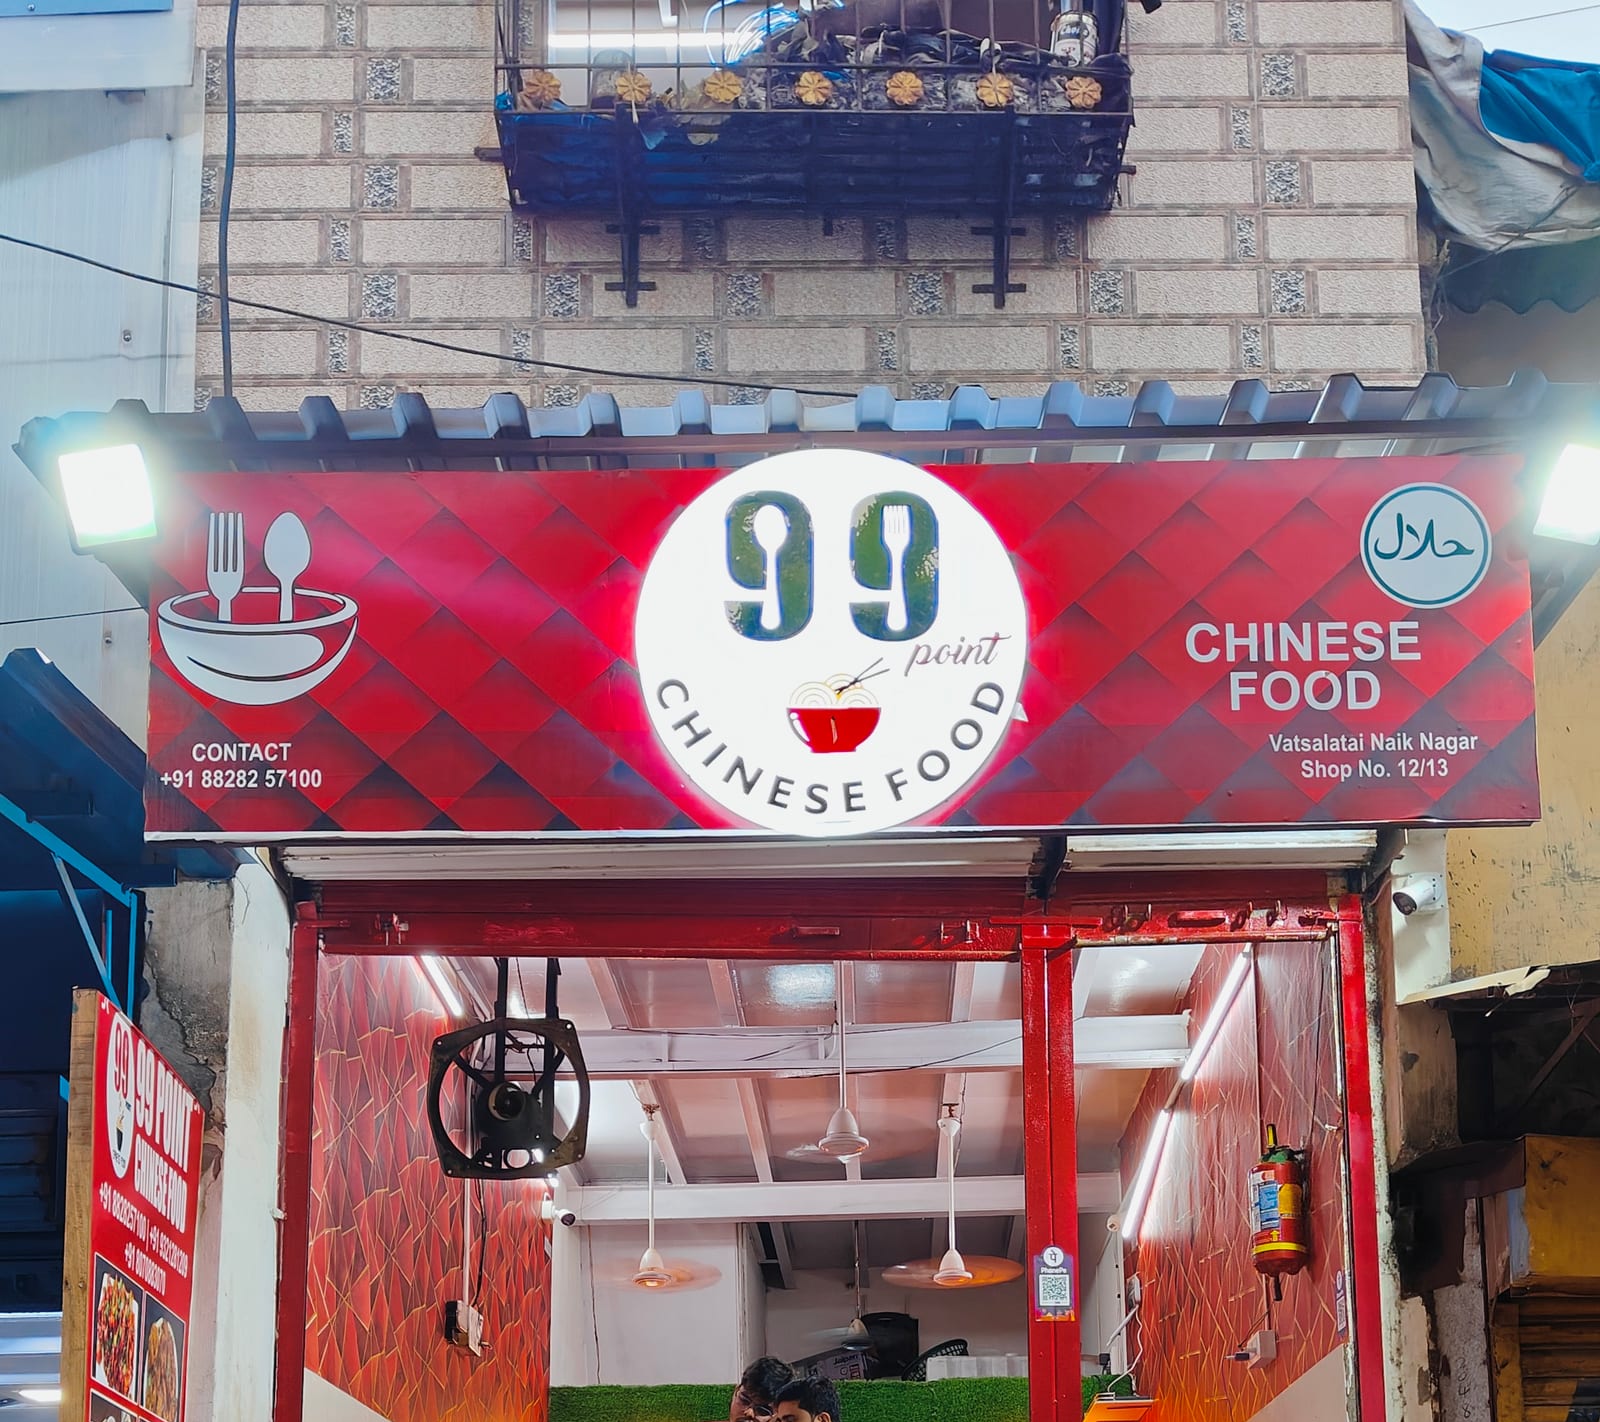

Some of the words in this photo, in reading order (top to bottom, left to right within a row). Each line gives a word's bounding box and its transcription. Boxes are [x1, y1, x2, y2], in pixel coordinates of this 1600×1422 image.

[1373, 512, 1475, 561] حلال
[723, 490, 939, 641] 99
[903, 631, 1012, 677] point
[1185, 620, 1421, 663] CHINESE
[1229, 670, 1381, 711] FOOD
[191, 742, 292, 762] CONTACT
[655, 679, 866, 815] CHINESE
[884, 681, 1005, 802] FOOD
[1269, 733, 1364, 753] Vatsalatai
[1370, 732, 1413, 751] Naik
[1419, 732, 1478, 755] Nagar
[160, 769, 194, 789] +91
[201, 769, 258, 789] 88282
[264, 769, 323, 789] 57100
[1301, 759, 1352, 782] Shop
[1358, 759, 1391, 779] No.
[1397, 758, 1449, 778] 12/13
[114, 1022, 130, 1100] 99
[135, 1038, 155, 1137] 99
[155, 1060, 196, 1174] POINT
[134, 1133, 168, 1217] CHINESE
[166, 1165, 188, 1234] FOOD
